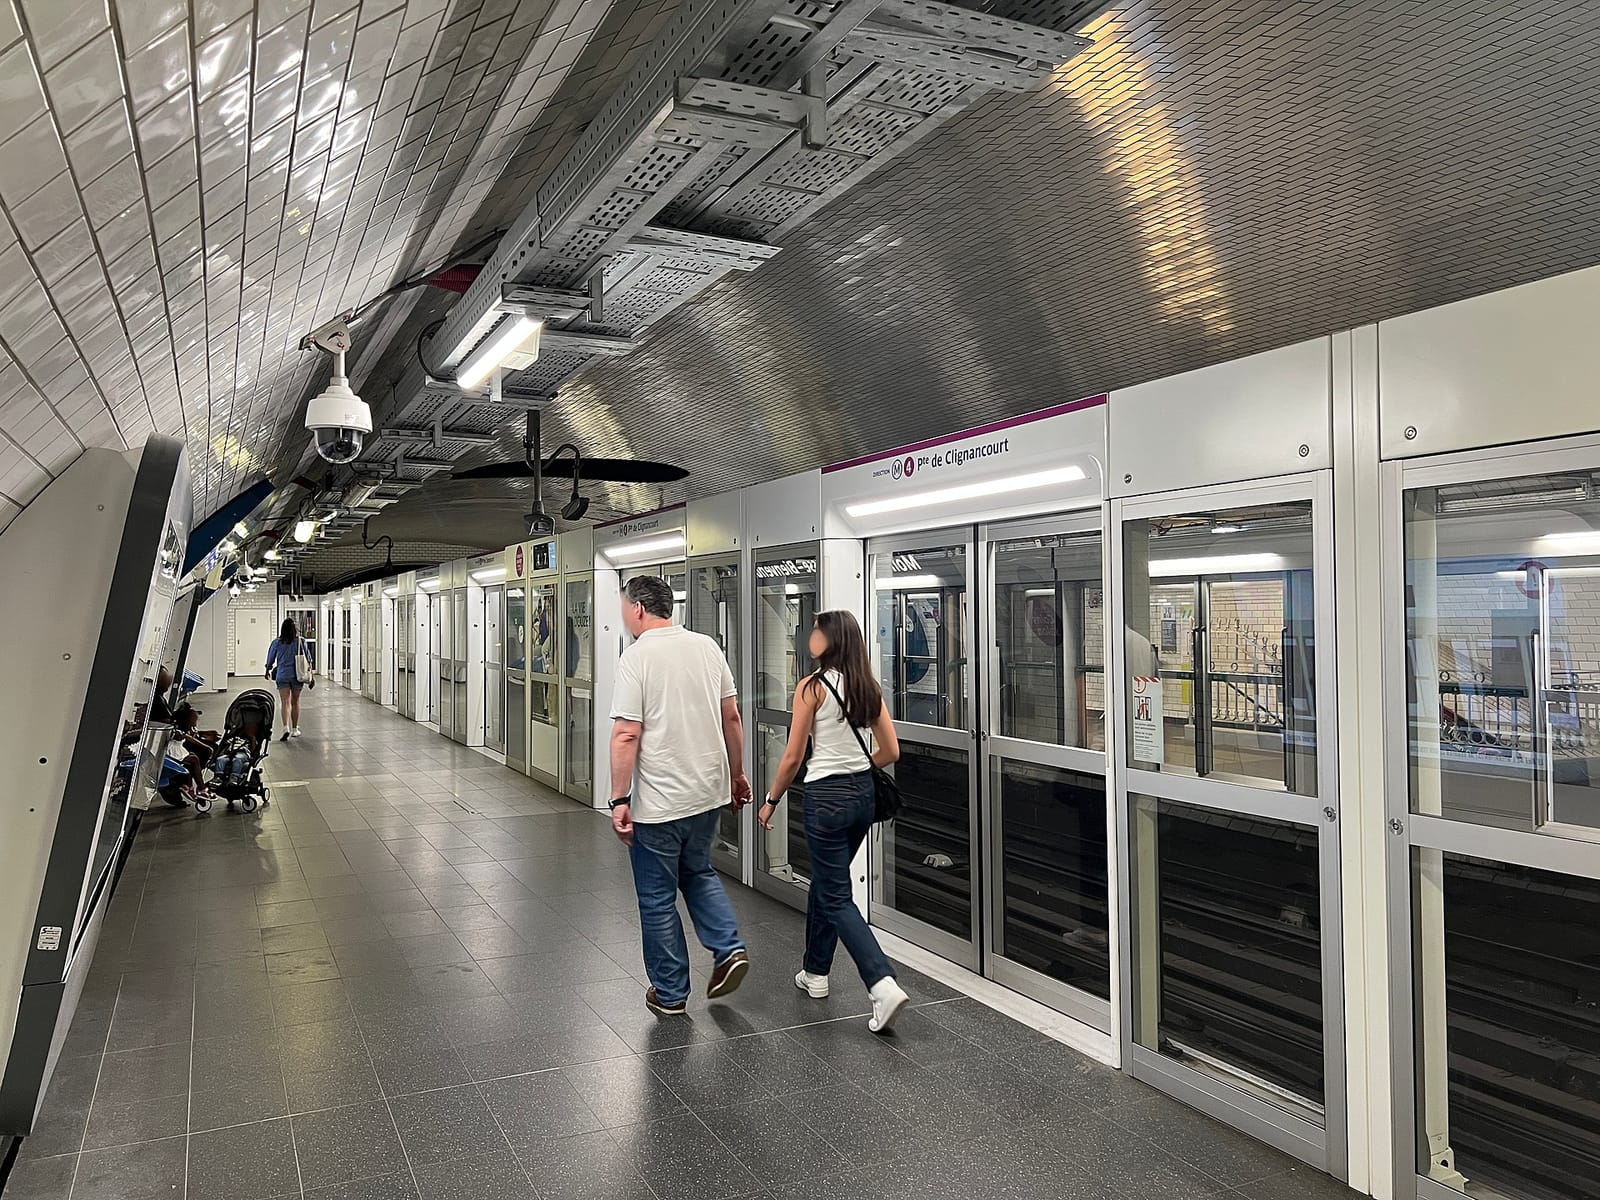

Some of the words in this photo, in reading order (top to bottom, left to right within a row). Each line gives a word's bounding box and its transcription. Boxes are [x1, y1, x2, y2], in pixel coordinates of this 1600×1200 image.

[872, 469, 890, 477] DIRECTION
[931, 453, 942, 468] de
[945, 438, 1009, 466] Clignancourt
